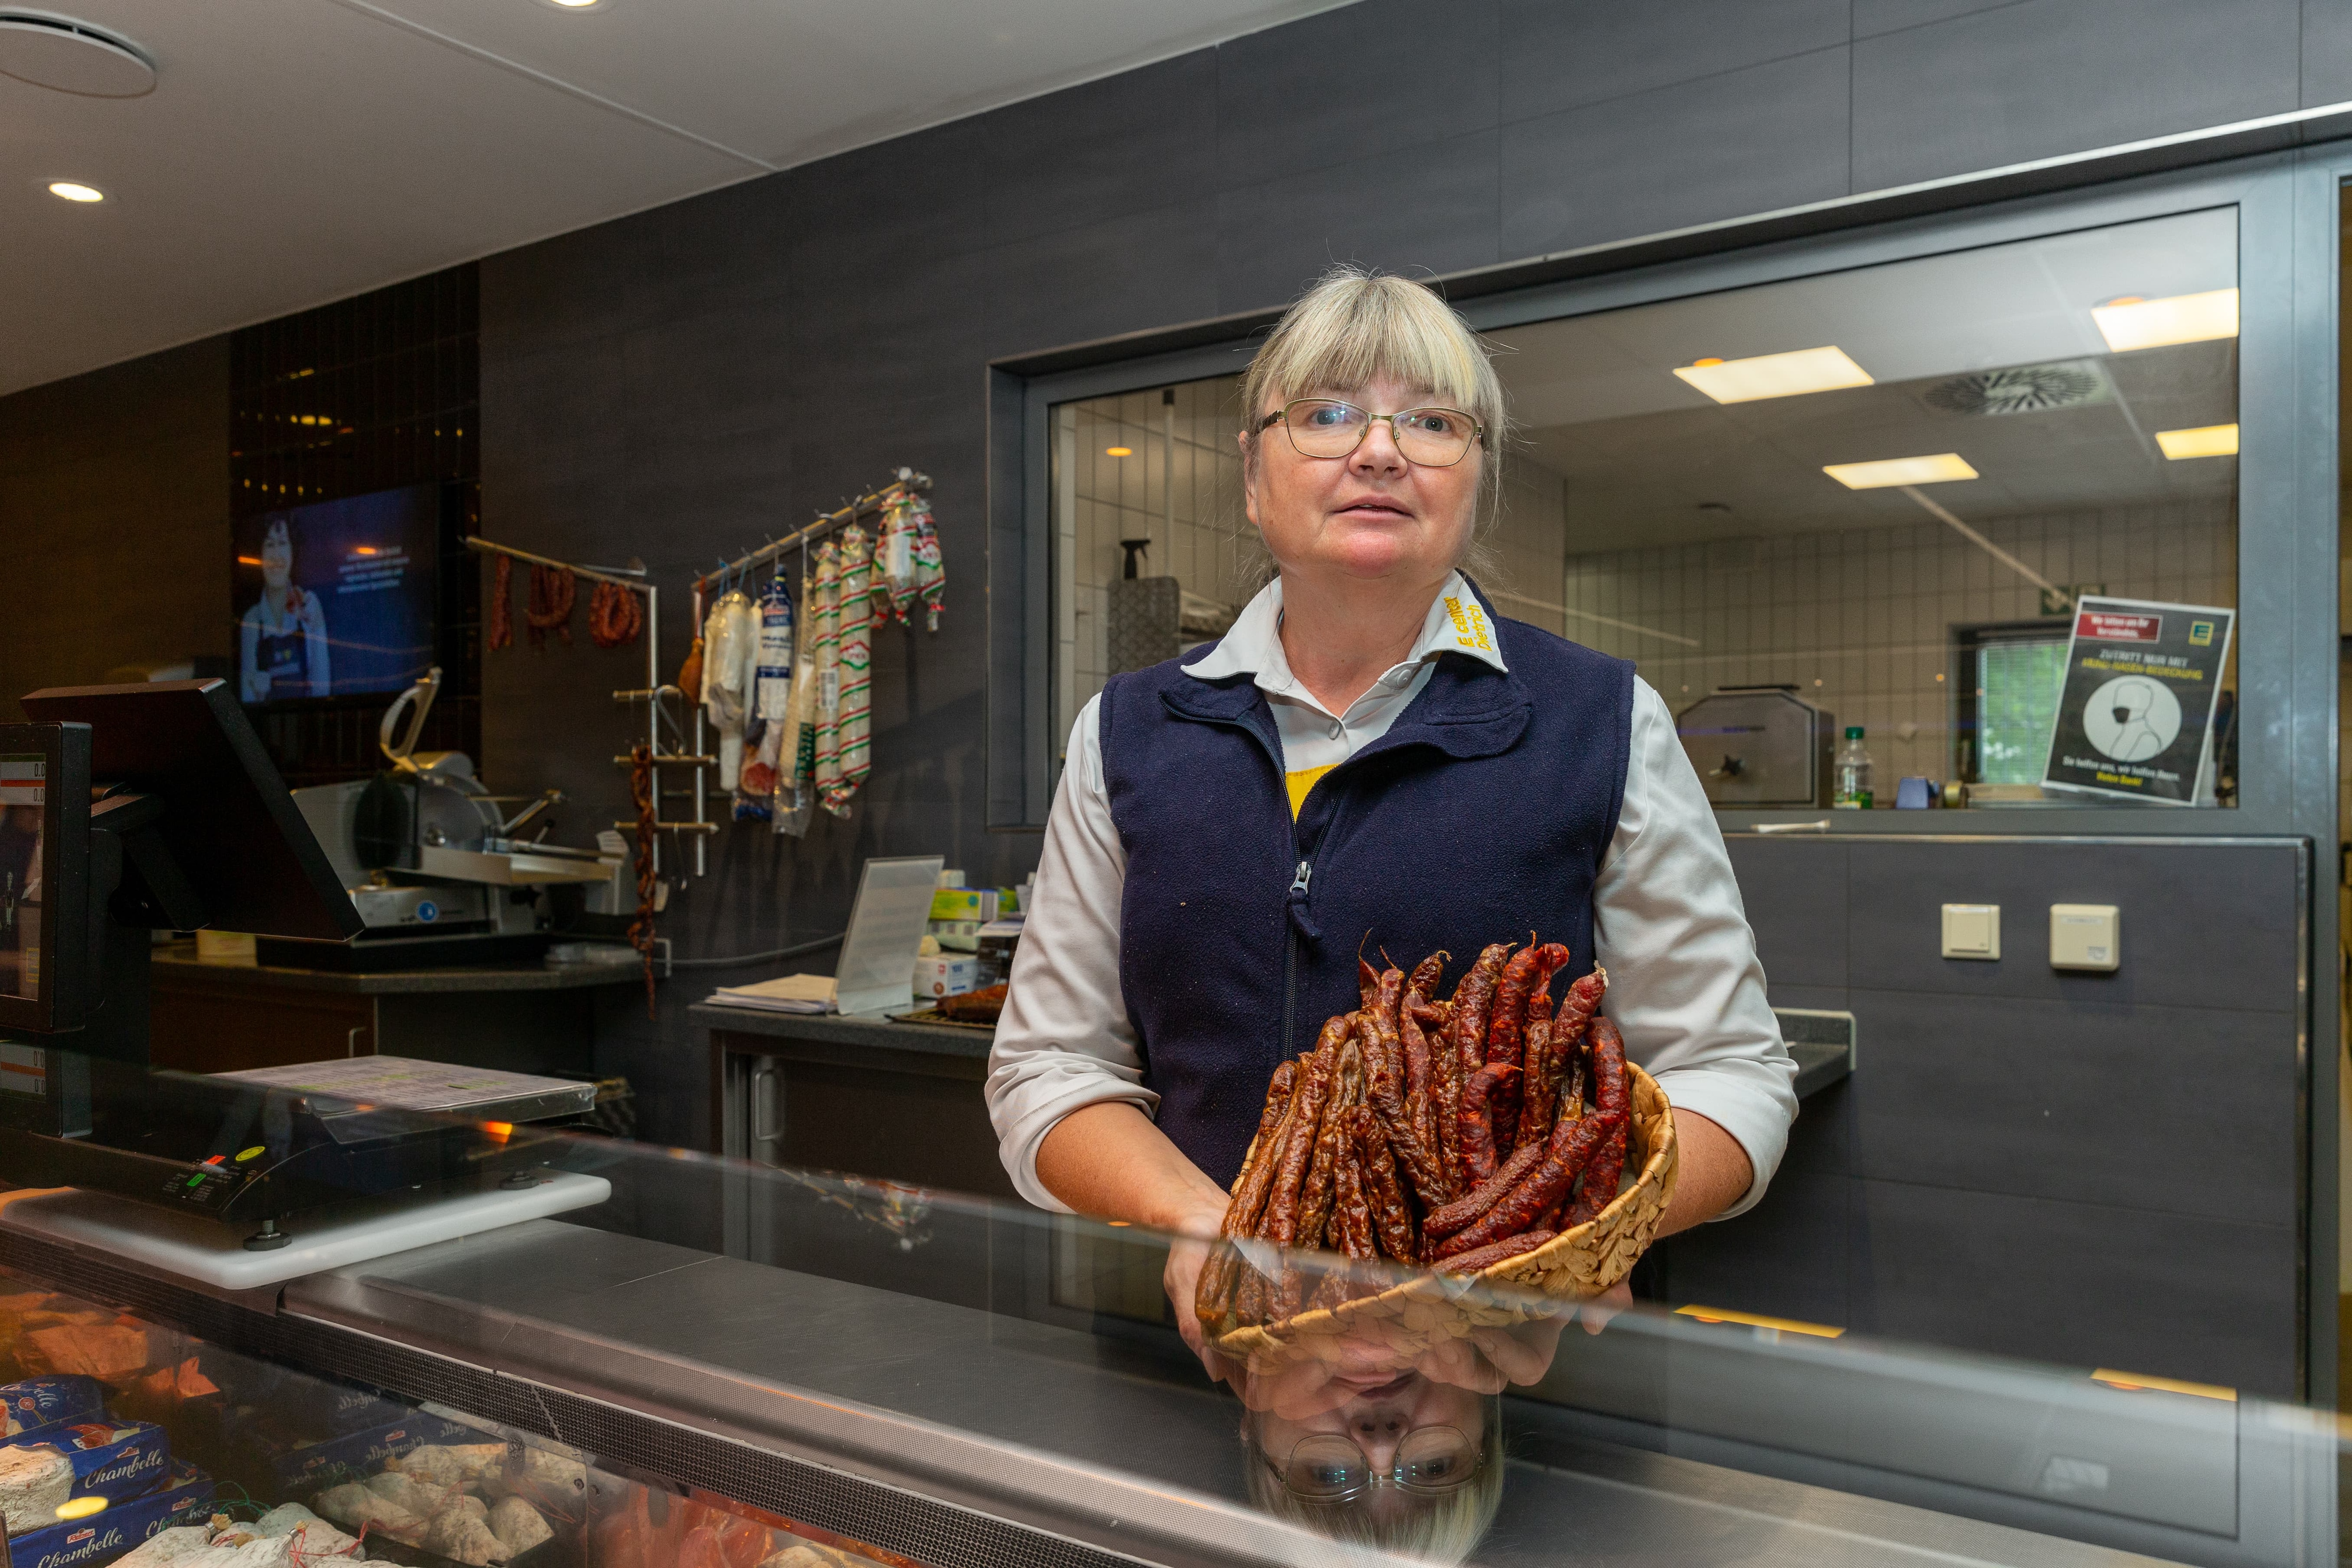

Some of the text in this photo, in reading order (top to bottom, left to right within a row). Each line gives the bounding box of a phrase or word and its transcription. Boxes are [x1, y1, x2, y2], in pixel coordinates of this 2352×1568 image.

[1457, 636, 1475, 647] E
[1466, 605, 1493, 652] Dietrich
[2099, 649, 2188, 668] ZUTRITT NUR MIT
[85, 1449, 164, 1489] Chambelle
[37, 1527, 123, 1568] Chambelle
